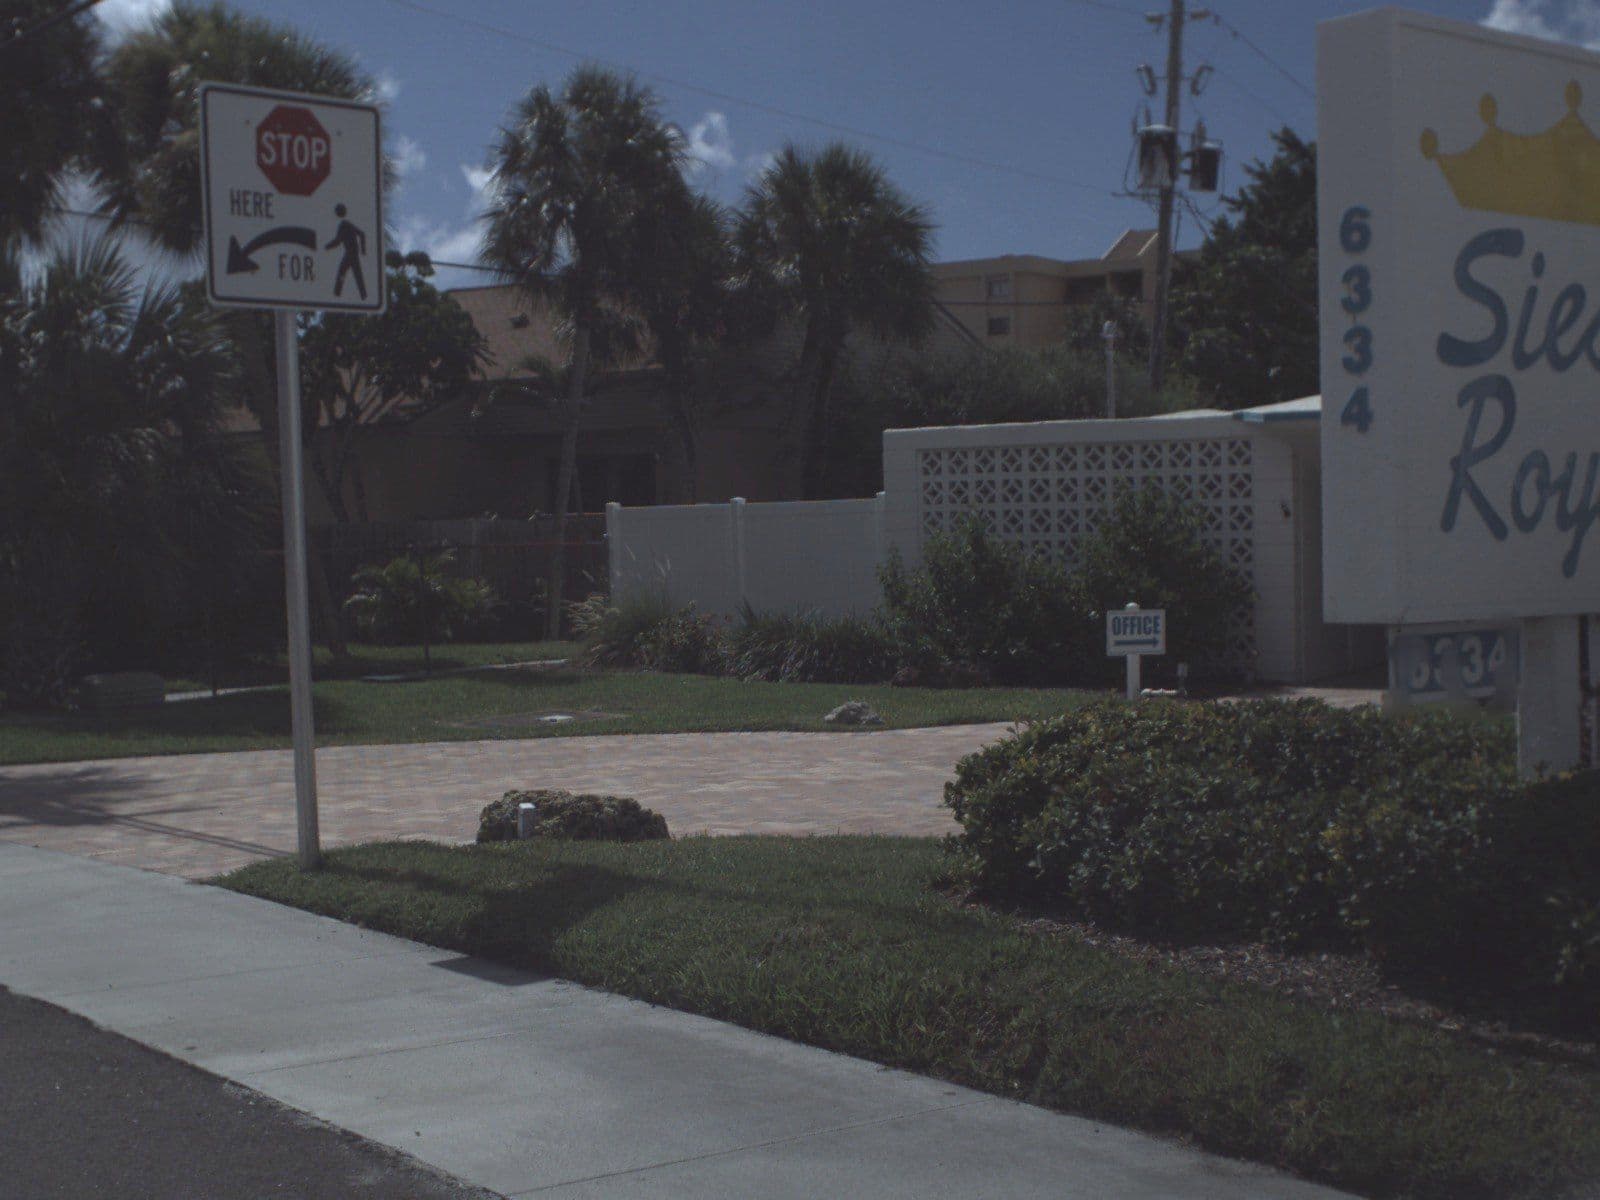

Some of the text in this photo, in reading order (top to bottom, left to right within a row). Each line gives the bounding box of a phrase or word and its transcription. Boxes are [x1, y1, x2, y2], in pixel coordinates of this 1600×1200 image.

[260, 131, 328, 170] STOP
[229, 188, 275, 219] HERE
[278, 253, 315, 282] FOR
[1339, 206, 1374, 434] 6334
[1112, 615, 1161, 635] OFFICE
